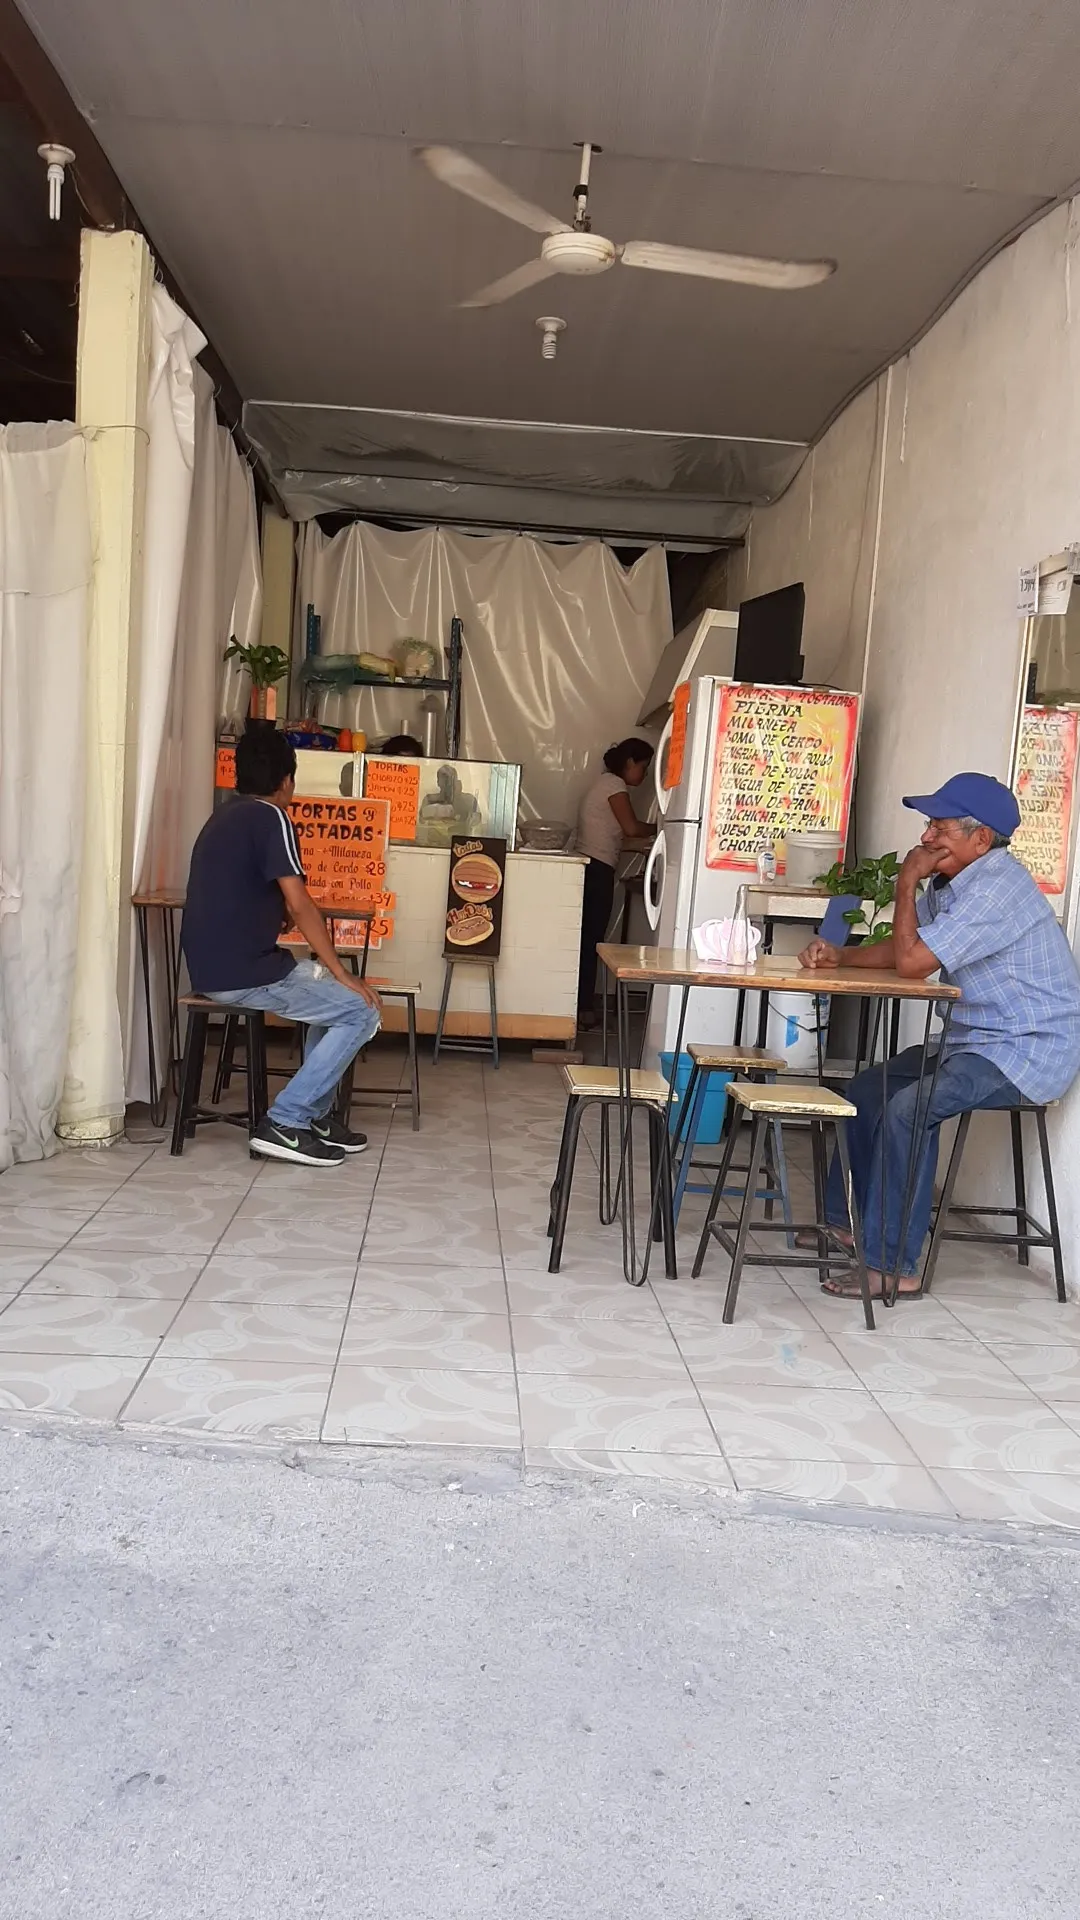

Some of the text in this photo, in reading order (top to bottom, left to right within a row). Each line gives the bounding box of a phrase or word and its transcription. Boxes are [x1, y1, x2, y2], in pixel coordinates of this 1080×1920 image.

[727, 687, 775, 702] TORTAS
[799, 693, 856, 708] TOSTADAS
[733, 700, 803, 717] PIERNA
[727, 716, 797, 733] MILANEZA
[725, 731, 822, 748] LOMO DE CERDO
[722, 747, 833, 766] ENSALADA CON POLLO
[375, 762, 408, 774] TORTAS
[719, 761, 819, 780] TINGA DE POLLO
[719, 777, 763, 791] LENGUA
[768, 781, 785, 793] DE
[718, 792, 763, 806] JAMON
[766, 796, 785, 809] DE
[289, 801, 357, 822] TORTAS
[716, 807, 777, 824] SALCHICHA
[779, 813, 797, 824] DE
[293, 821, 373, 842] OSTADAS
[714, 823, 751, 838] QUESO
[318, 862, 327, 872] de
[334, 863, 359, 874] Cerdo
[350, 878, 372, 890] Pollo
